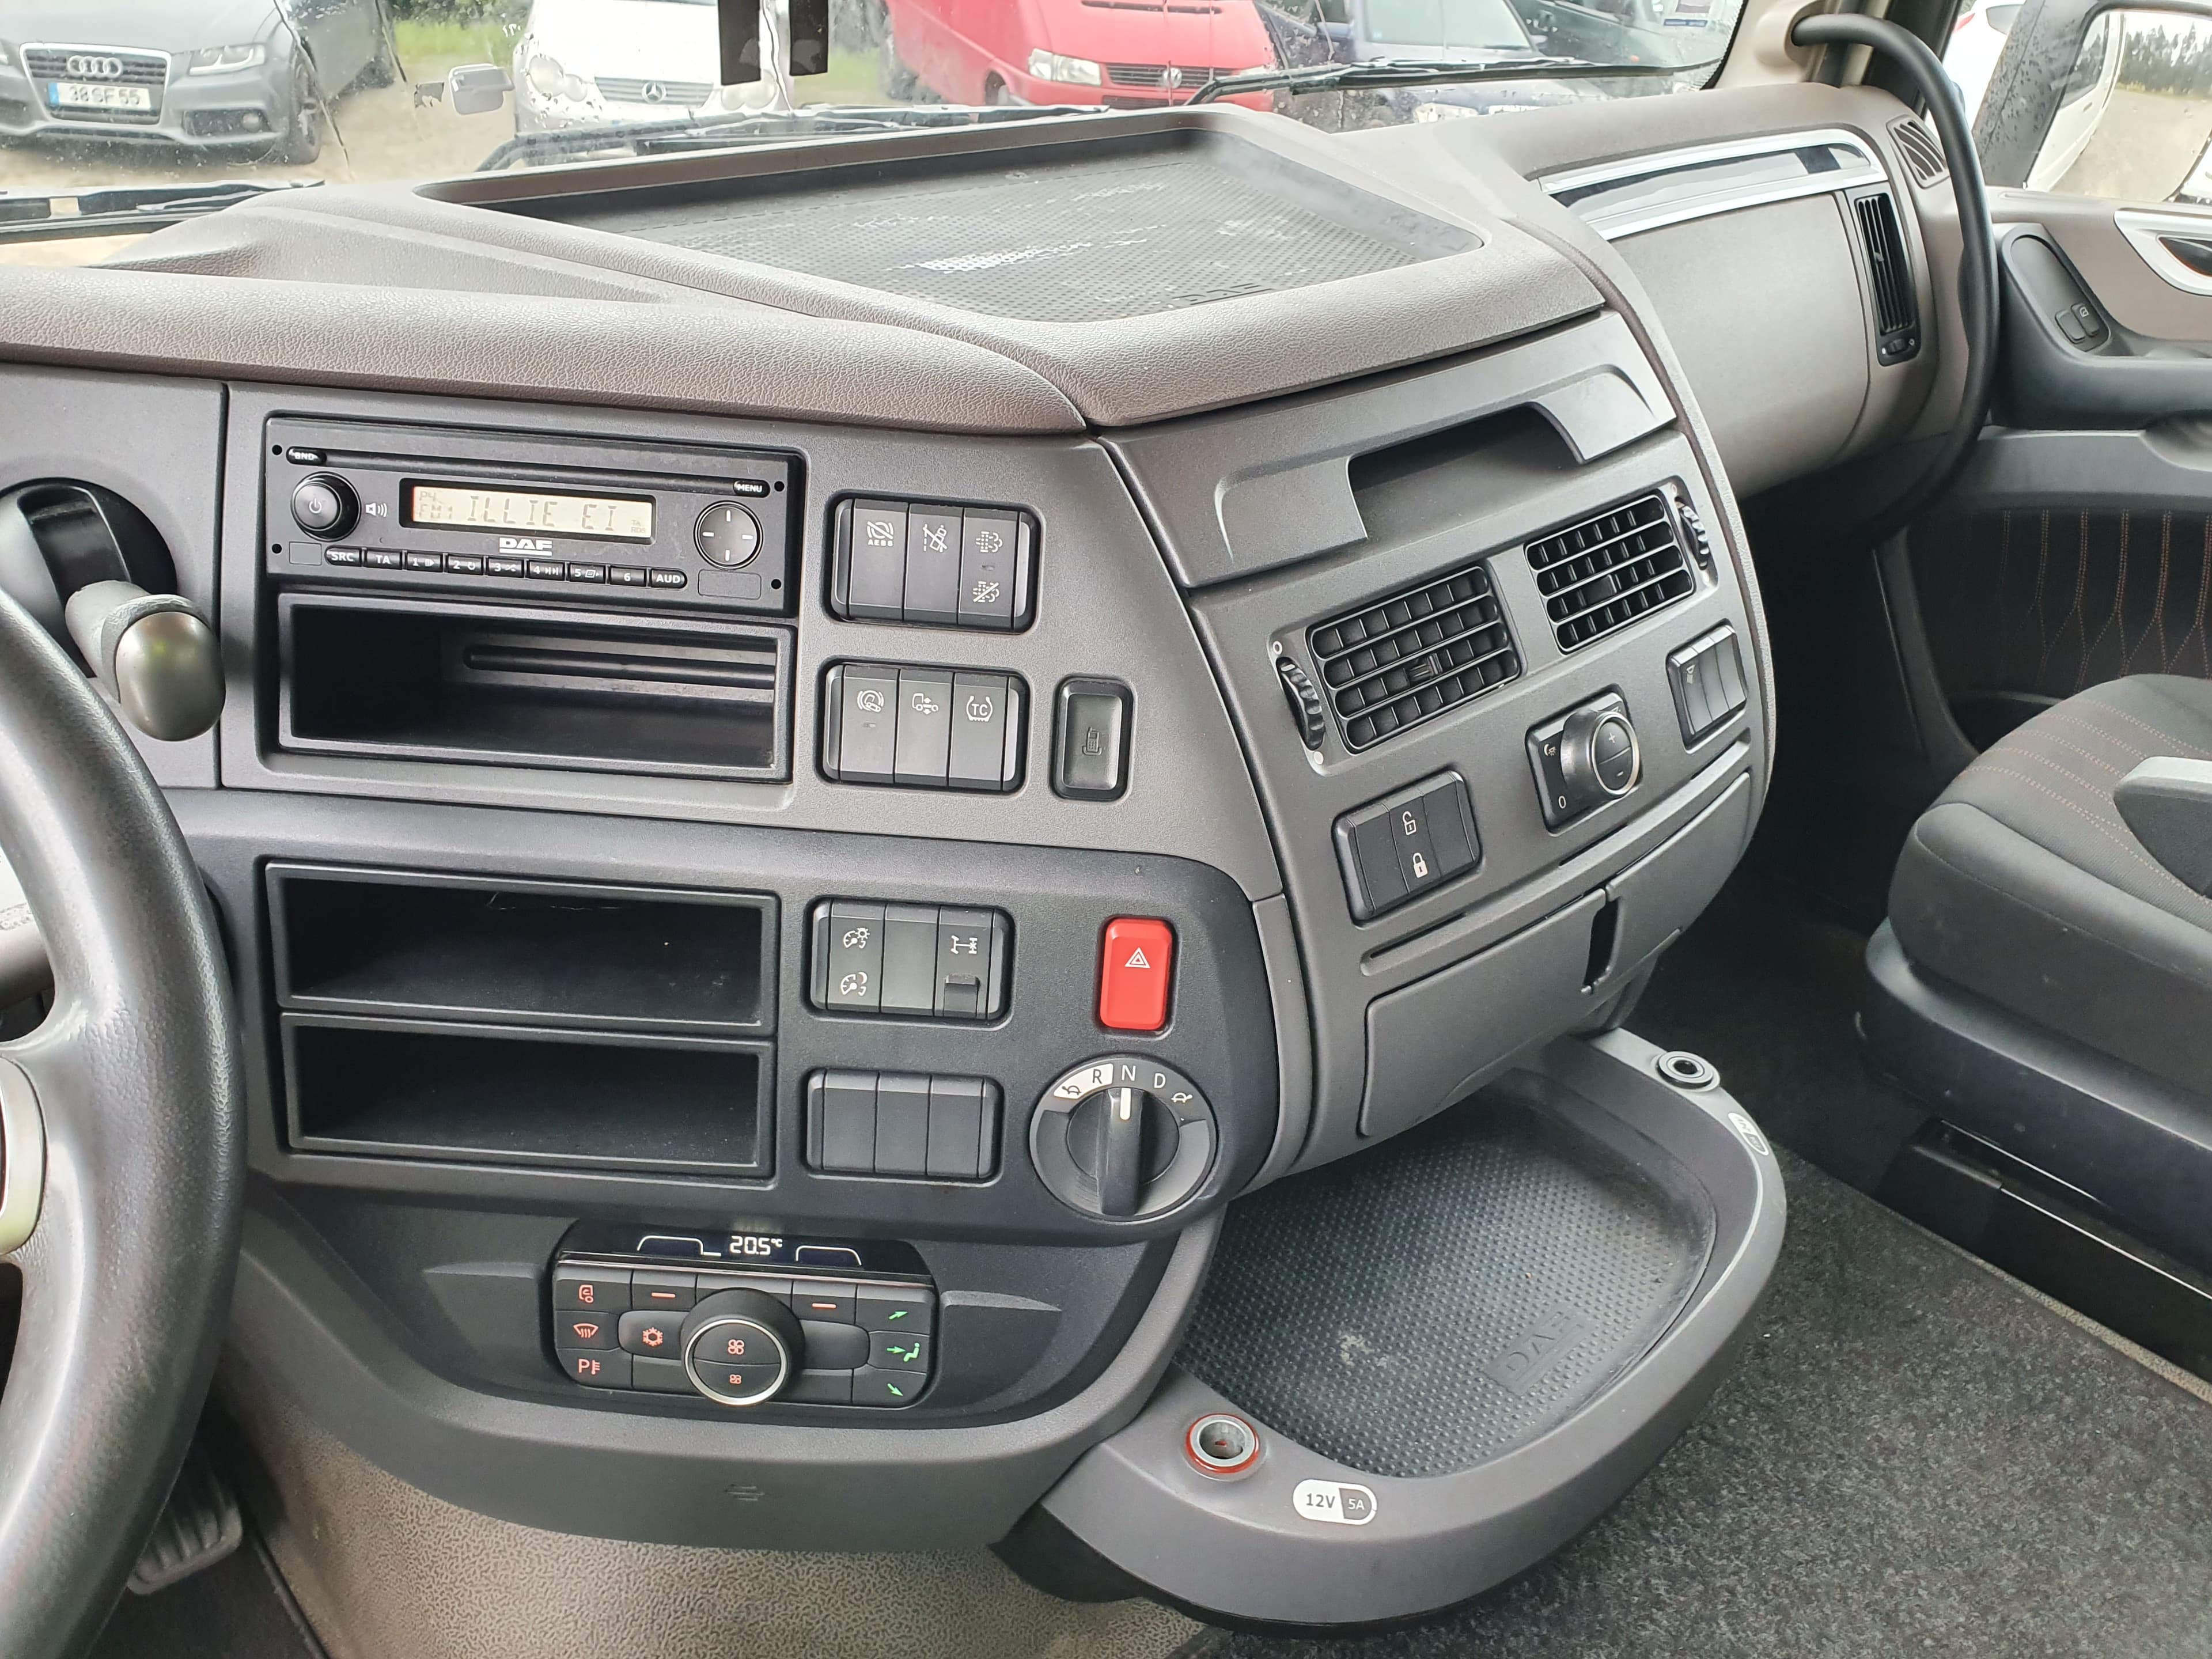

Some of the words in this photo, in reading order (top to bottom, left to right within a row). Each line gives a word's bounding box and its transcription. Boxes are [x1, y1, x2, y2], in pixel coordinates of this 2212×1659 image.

[737, 483, 763, 493] MENU
[499, 537, 552, 551] DAF
[331, 551, 354, 562] SRC
[375, 555, 391, 565] TA
[412, 556, 419, 567] 1
[453, 560, 460, 570] 2
[494, 562, 501, 572] 3
[533, 565, 540, 575] 4
[574, 568, 581, 578] 5
[623, 573, 631, 582] 6
[656, 574, 681, 584] AUD
[971, 703, 988, 716] TC
[1092, 1069, 1103, 1084] R
[1121, 1065, 1137, 1081] N
[1154, 1073, 1166, 1089] D
[1306, 1493, 1336, 1509] 12V
[1348, 1498, 1365, 1510] 5A
